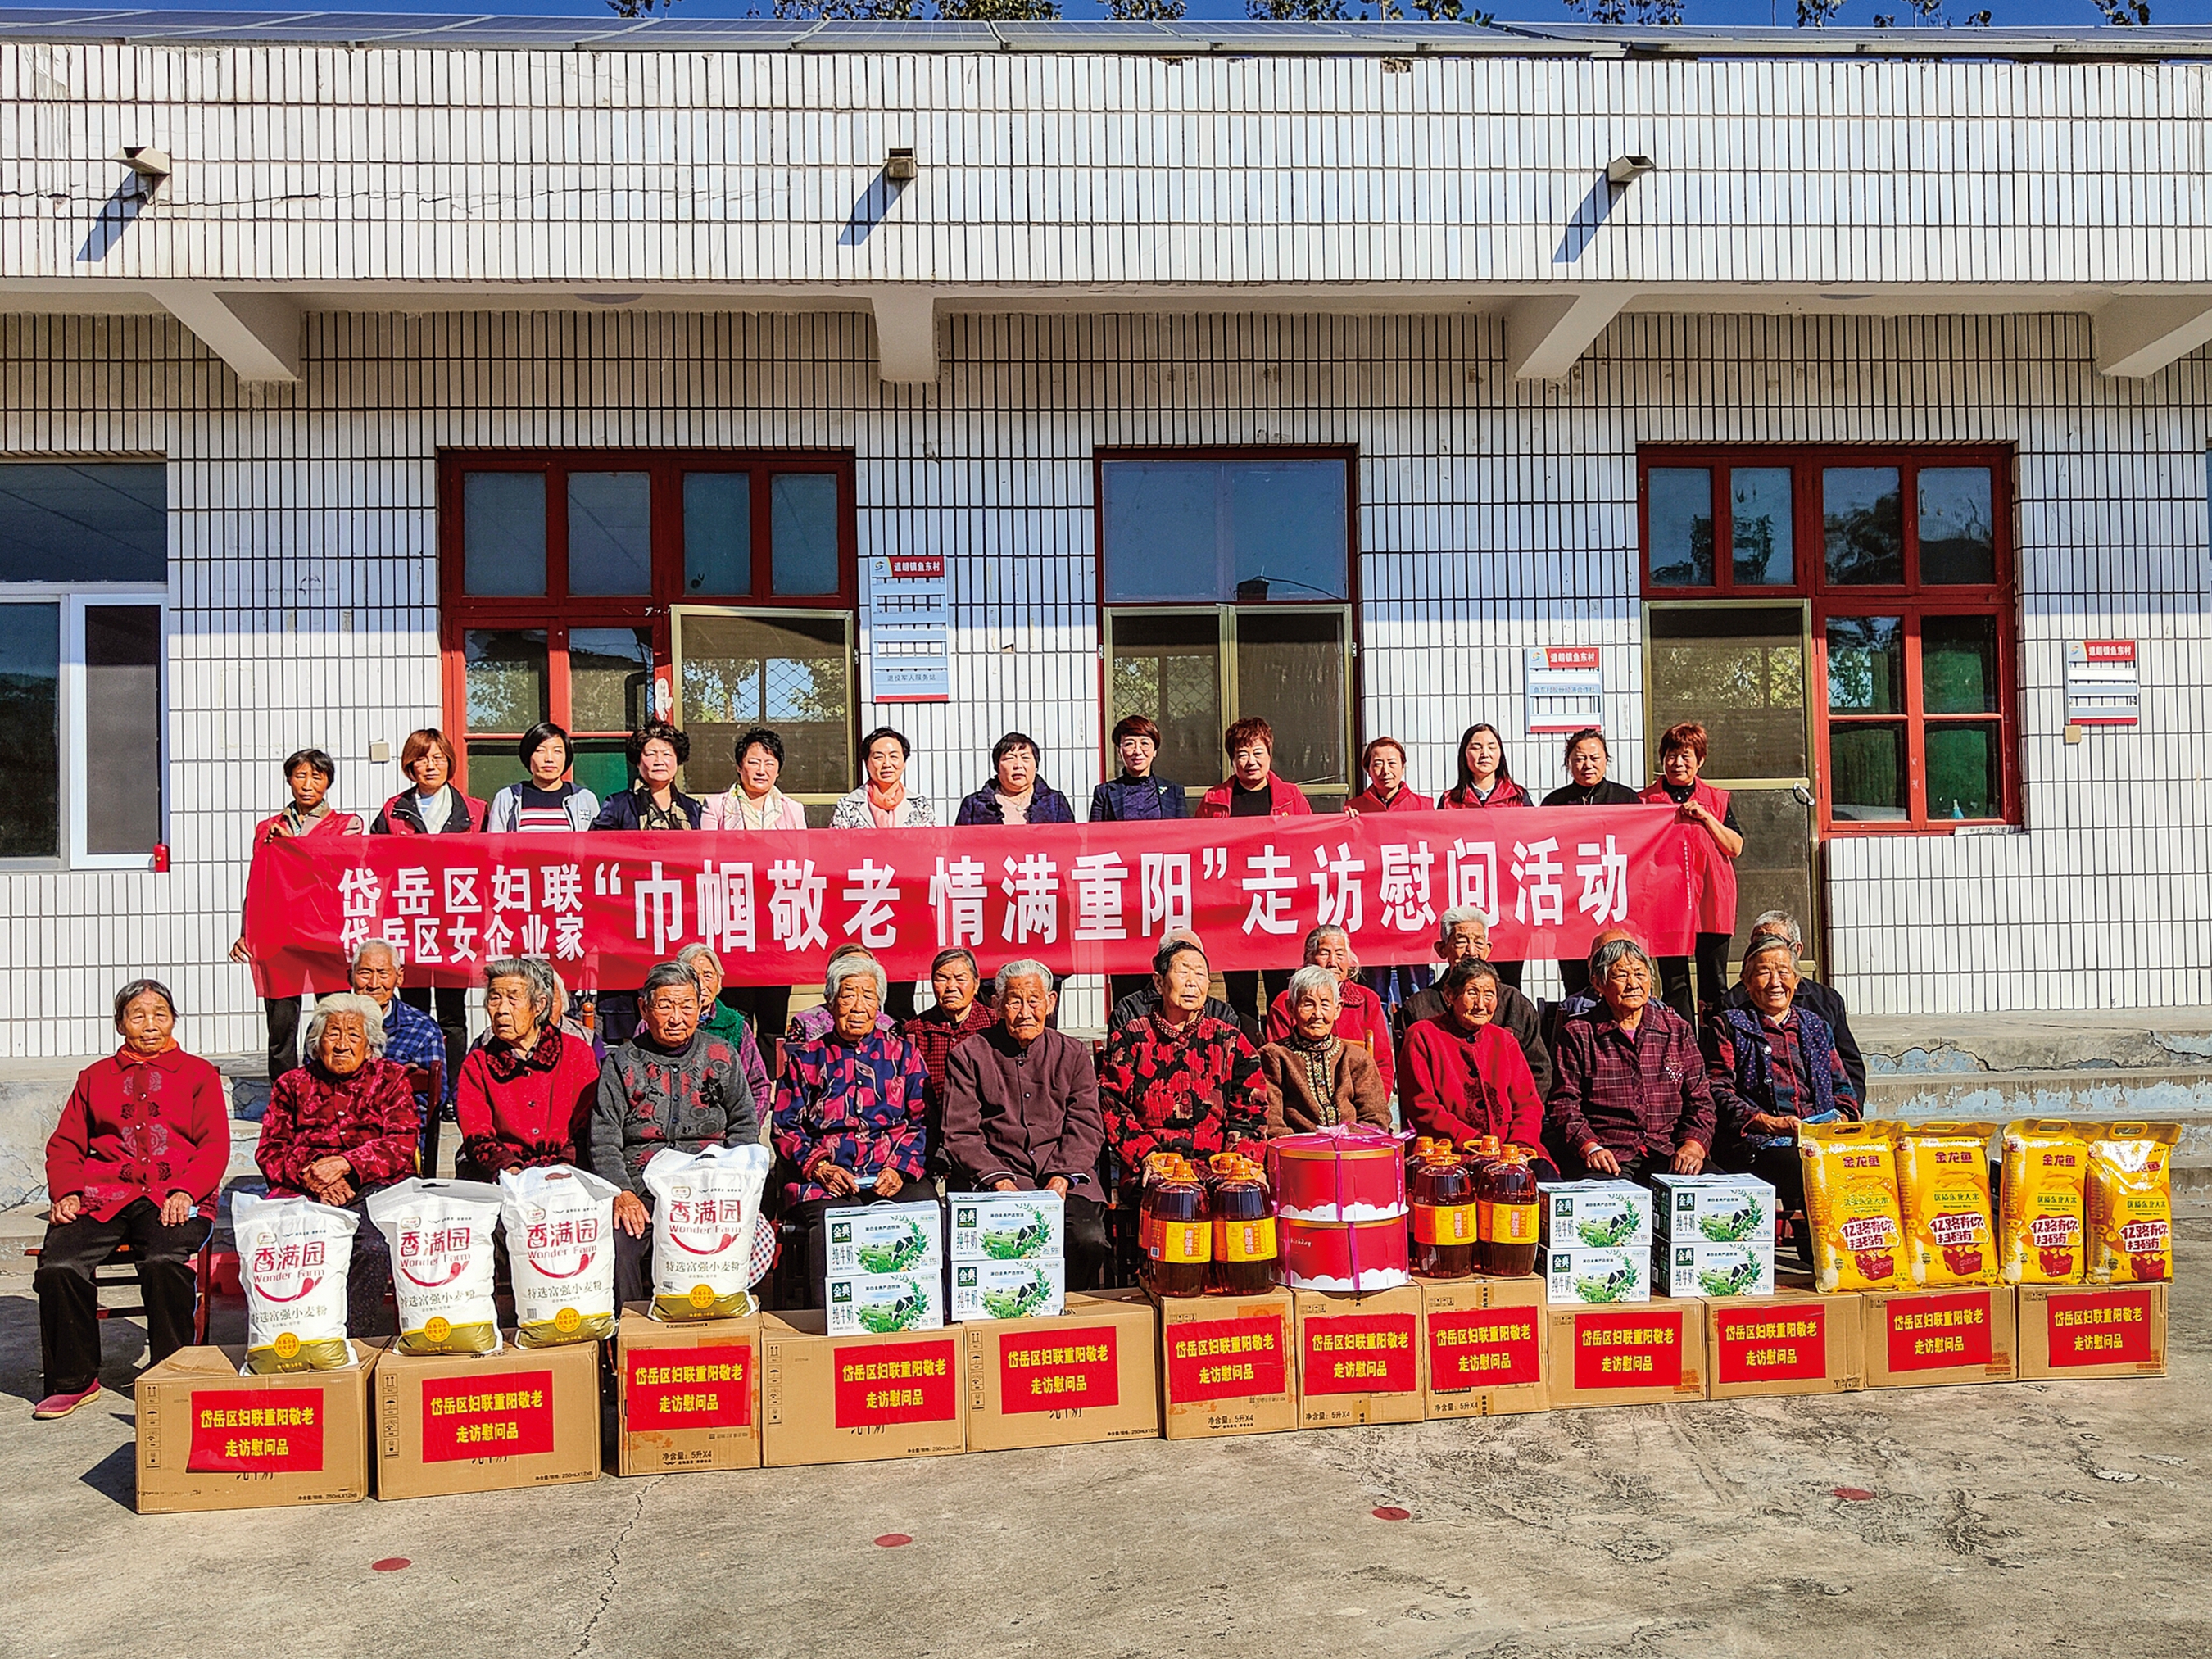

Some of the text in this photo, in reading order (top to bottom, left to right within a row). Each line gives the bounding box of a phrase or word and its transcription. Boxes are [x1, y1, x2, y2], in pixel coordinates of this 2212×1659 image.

[338, 865, 583, 918] 岱岳区妇联
[339, 913, 585, 963] 岱岳区女企业家
[1843, 1155, 1880, 1168] 金龙鱼
[1935, 1152, 1973, 1163] 金龙鱼
[2042, 1154, 2076, 1167] 金龙鱼
[1556, 1200, 1572, 1212] 金典
[1678, 1195, 1694, 1207] 金典
[669, 1199, 741, 1224] 香满园
[958, 1209, 976, 1222] 金典
[527, 1218, 598, 1249] 香满园
[669, 1224, 741, 1235] Wonder Farm
[833, 1224, 850, 1237] 金典
[1929, 1216, 1984, 1233] 亿路有你
[2031, 1218, 2078, 1234] 亿路有你
[2121, 1223, 2169, 1240] 亿路有你
[400, 1227, 470, 1257] 香满园
[528, 1244, 597, 1259] Wonder Farm
[253, 1240, 325, 1273] 香满园
[400, 1253, 471, 1267] Wonder Farm
[1553, 1256, 1570, 1268] 金典
[1677, 1250, 1693, 1261] 金典
[253, 1268, 325, 1284] Wonder Farm
[665, 1260, 740, 1273] 特选富强小麦粉
[959, 1268, 976, 1281] 金典
[528, 1281, 602, 1299] 特选富强小麦粉
[833, 1284, 850, 1297] 金典
[1893, 1308, 1983, 1331] 岱岳区妇联重阳敬老
[2054, 1306, 2143, 1327] 岱岳区妇联重阳敬老
[1435, 1323, 1531, 1347] 岱岳区妇联重阳敬老
[1581, 1328, 1675, 1347] 岱岳区妇联重阳敬老
[1725, 1321, 1817, 1342] 岱岳区妇联重阳敬老
[1175, 1333, 1275, 1359] 岱岳区妇联重阳敬老
[1312, 1331, 1408, 1352] 岱岳区妇联重阳敬老
[1914, 1335, 1965, 1355] 走访慰问品
[2074, 1333, 2124, 1352] 走访慰问品
[1007, 1344, 1108, 1368] 岱岳区妇联重阳敬老
[1458, 1353, 1512, 1372] 走访慰问品
[1601, 1355, 1653, 1372] 走访慰问品
[1746, 1349, 1797, 1367] 走访慰问品
[635, 1363, 743, 1385] 岱岳区妇联重阳敬老
[842, 1358, 946, 1382] 岱岳区妇联重阳敬老
[1199, 1363, 1254, 1384] 走访慰问品
[1334, 1360, 1387, 1378] 走访慰问品
[1031, 1375, 1087, 1395] 走访慰问品
[430, 1389, 543, 1416] 岱岳区妇联重阳敬老
[659, 1394, 718, 1413] 走访慰问品
[866, 1389, 924, 1409] 走访慰问品
[200, 1407, 315, 1428] 岱岳区妇联重阳敬老
[456, 1421, 519, 1444] 走访慰问品
[225, 1438, 288, 1457] 走访慰问品
